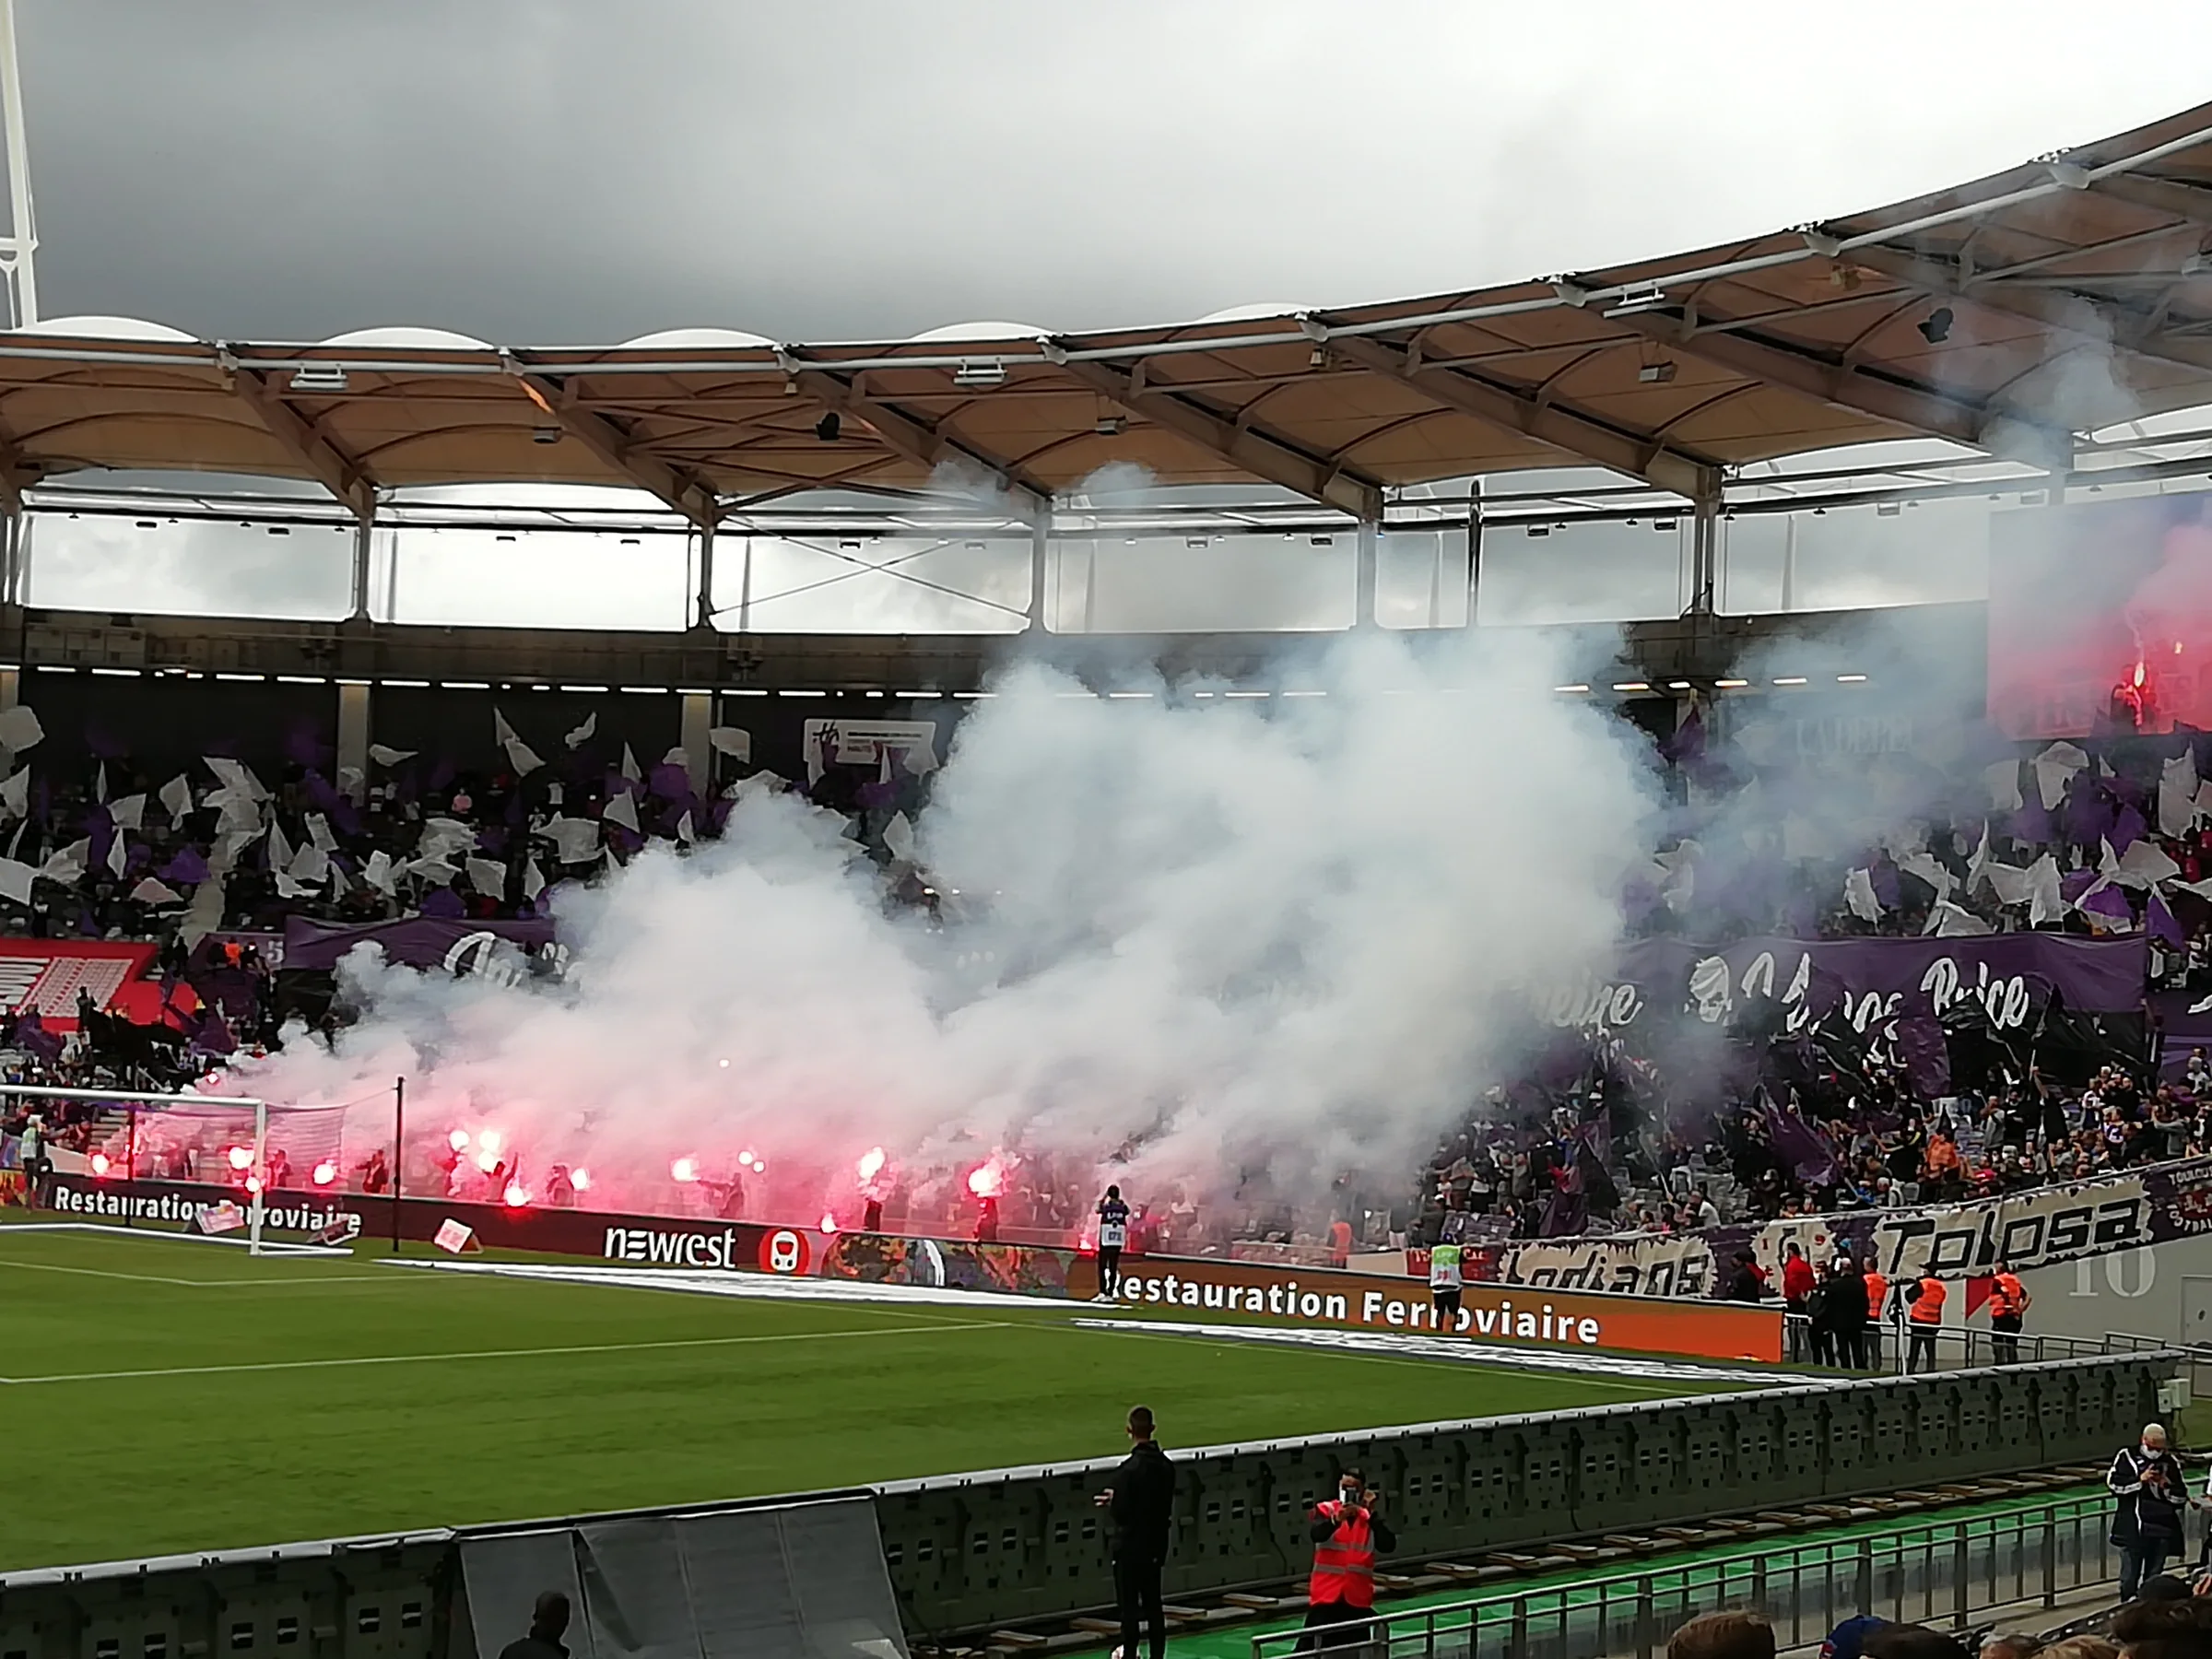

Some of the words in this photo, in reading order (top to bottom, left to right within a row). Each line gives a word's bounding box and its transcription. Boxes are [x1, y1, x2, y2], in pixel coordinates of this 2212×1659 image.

[605, 1228, 736, 1269] newrest
[1882, 1197, 2142, 1275] Tolosa
[2069, 1244, 2157, 1298] 10
